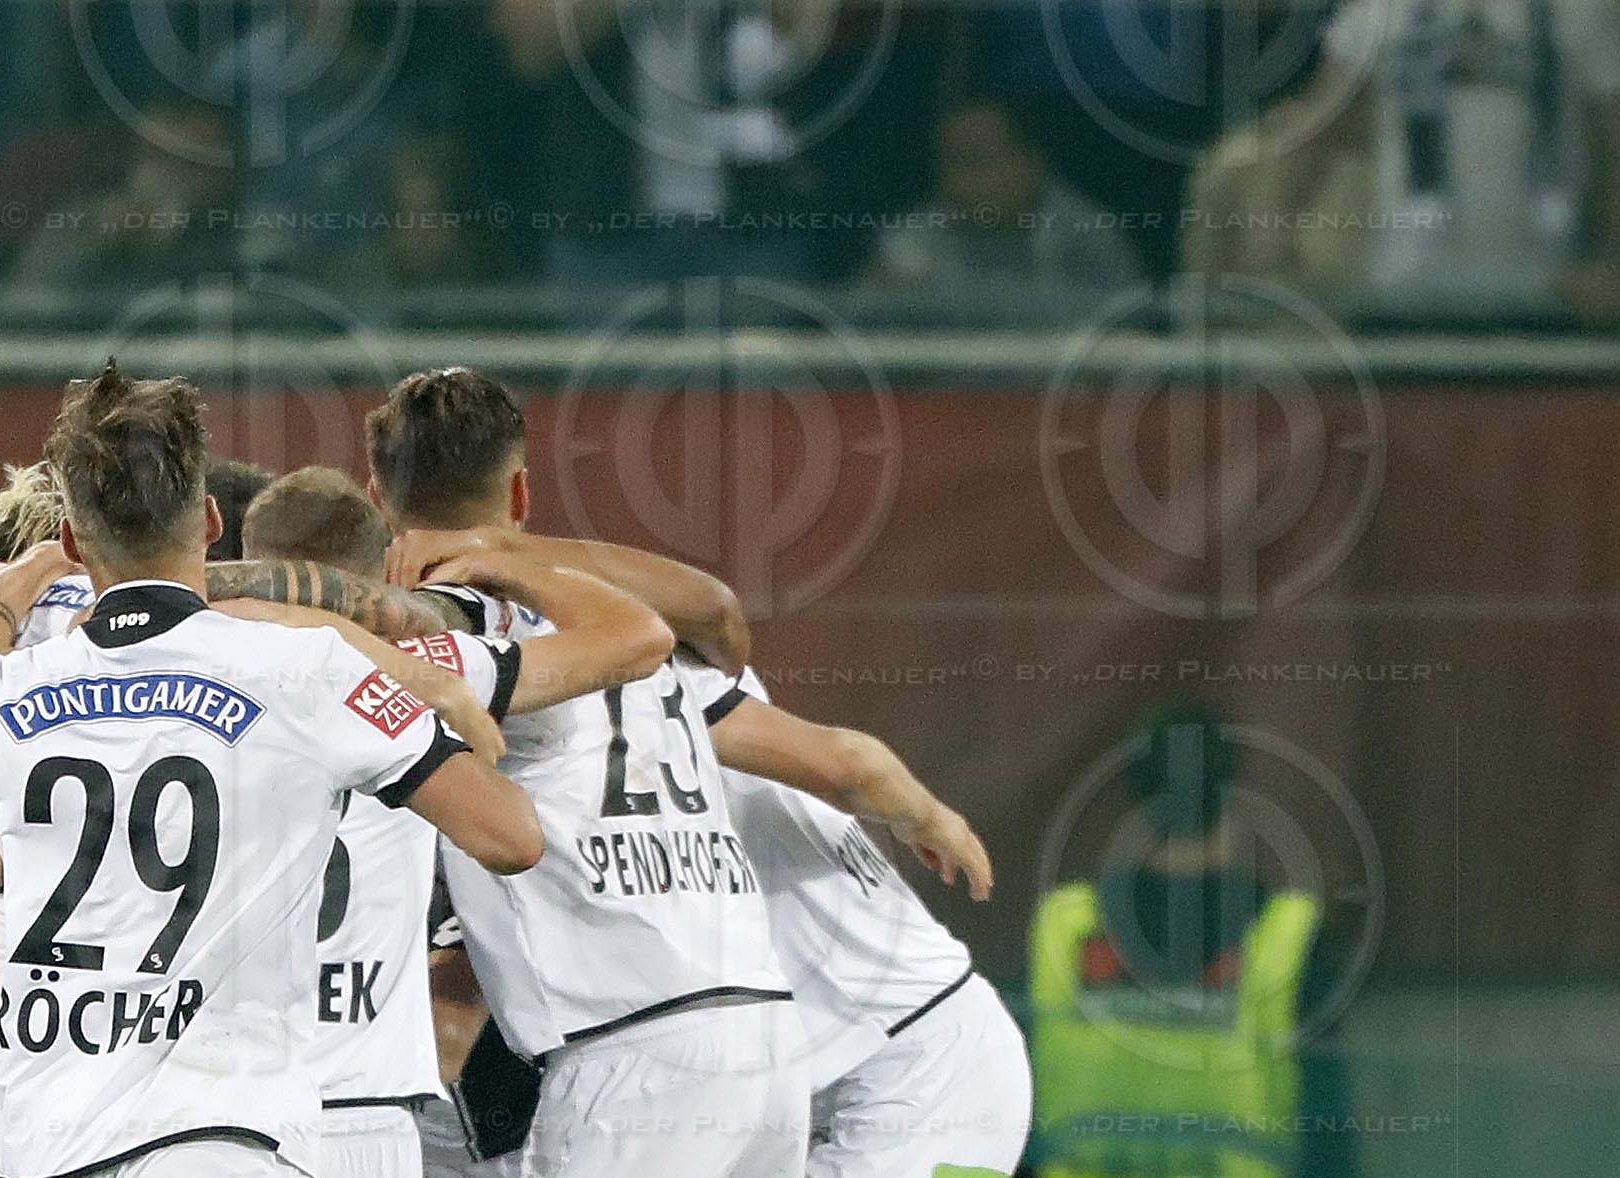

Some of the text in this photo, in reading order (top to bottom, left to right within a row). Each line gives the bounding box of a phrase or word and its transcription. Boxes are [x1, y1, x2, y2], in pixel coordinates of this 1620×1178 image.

[108, 611, 150, 631] 1909
[10, 682, 246, 738] PUNTIGAMER
[9, 755, 221, 976] 29
